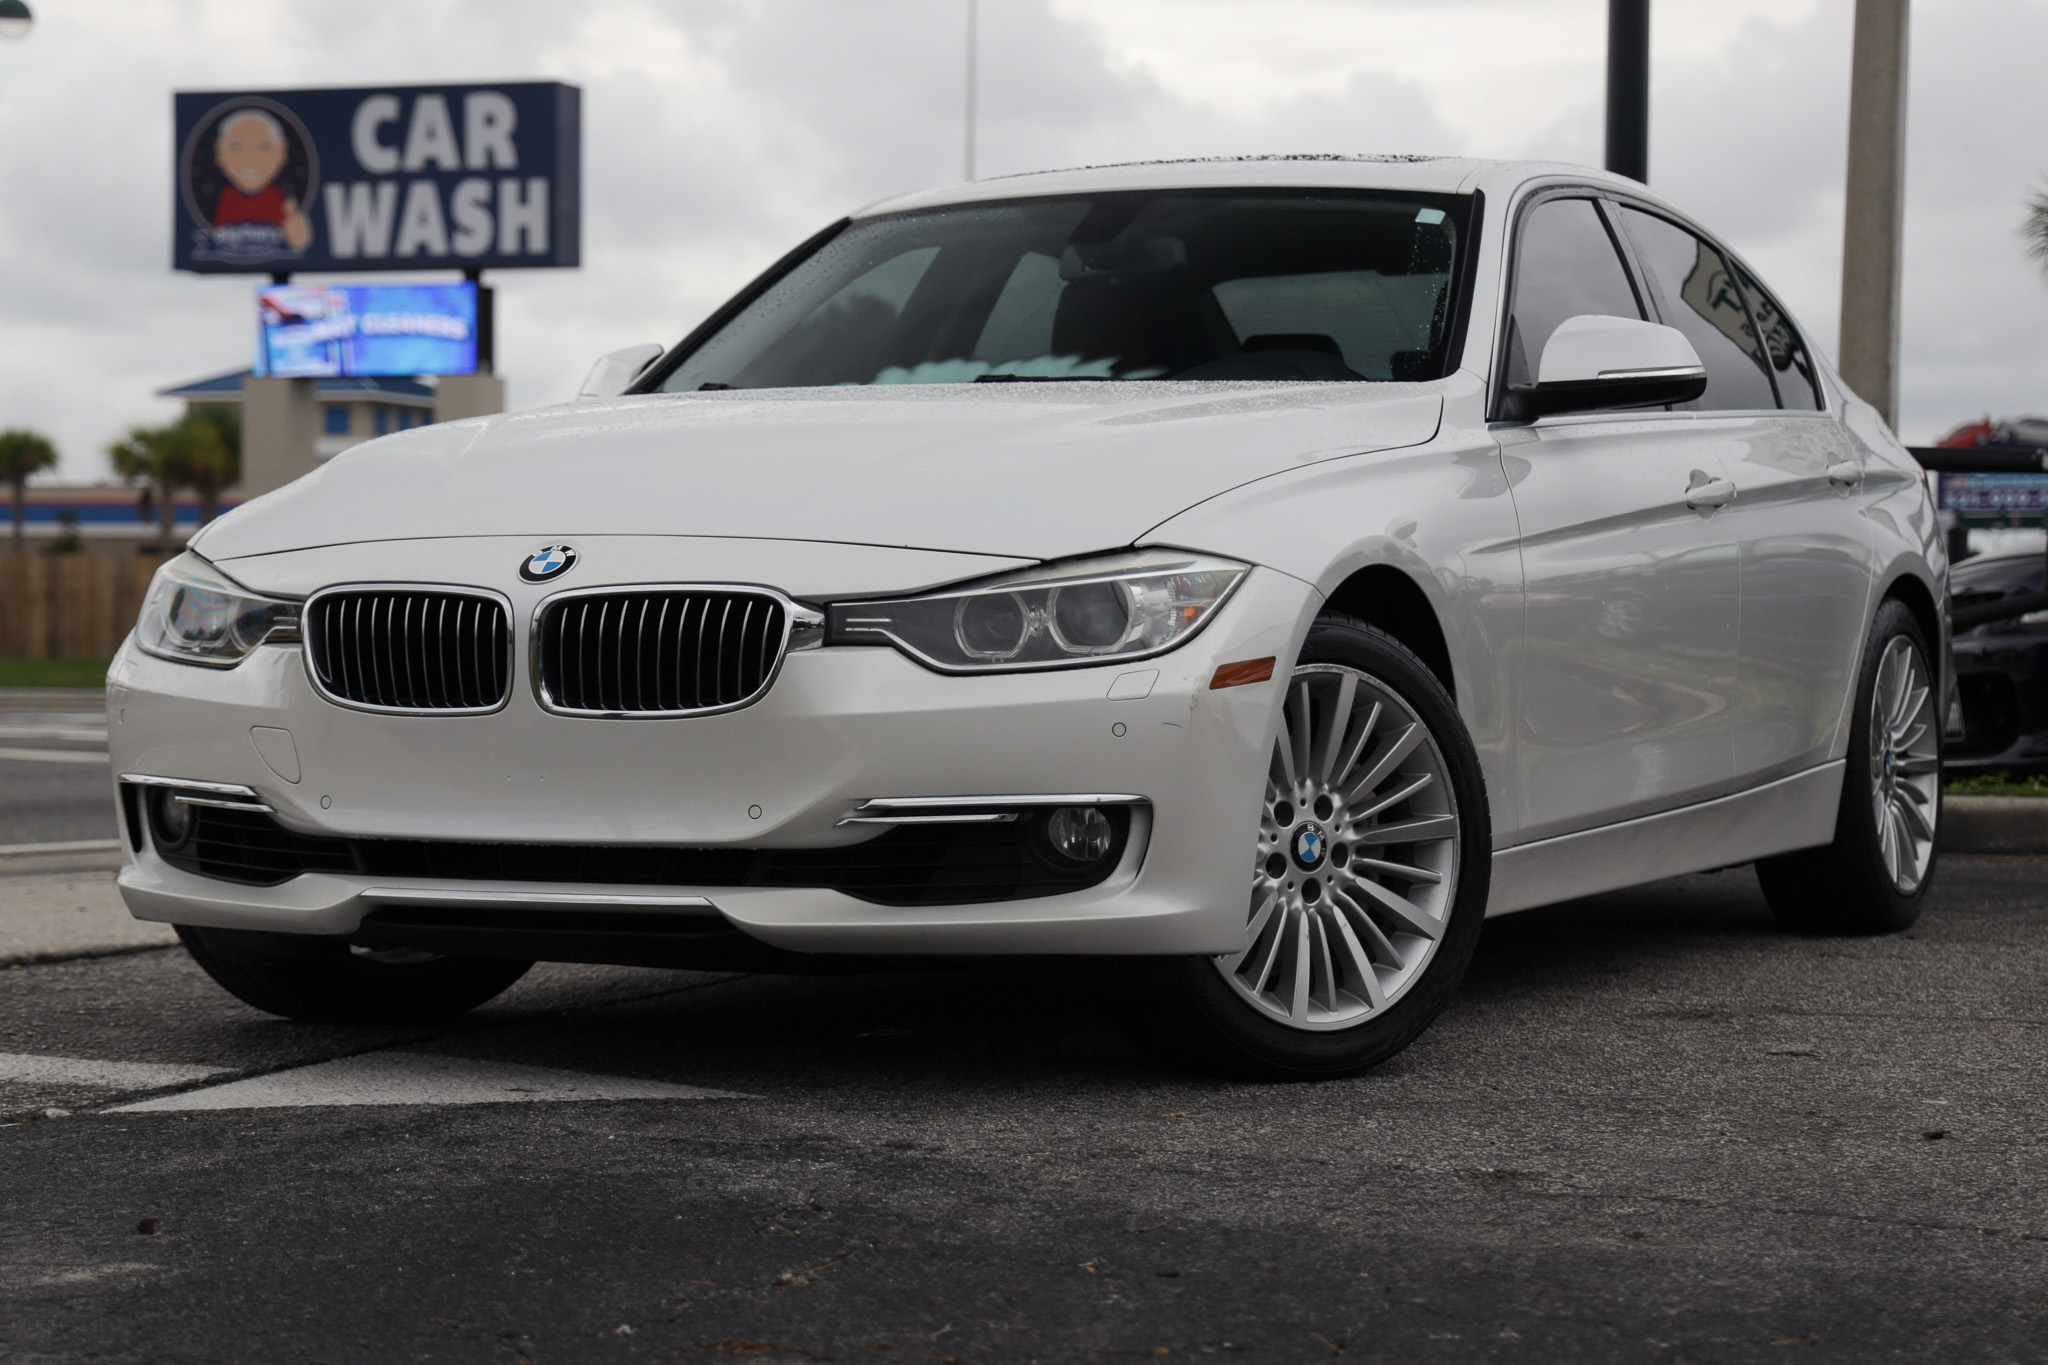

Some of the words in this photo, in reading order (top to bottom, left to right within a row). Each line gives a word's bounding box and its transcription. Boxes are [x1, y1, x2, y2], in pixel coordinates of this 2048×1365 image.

[351, 91, 518, 174] CAR
[323, 177, 550, 259] WASH
[1307, 823, 1327, 857] BMW
